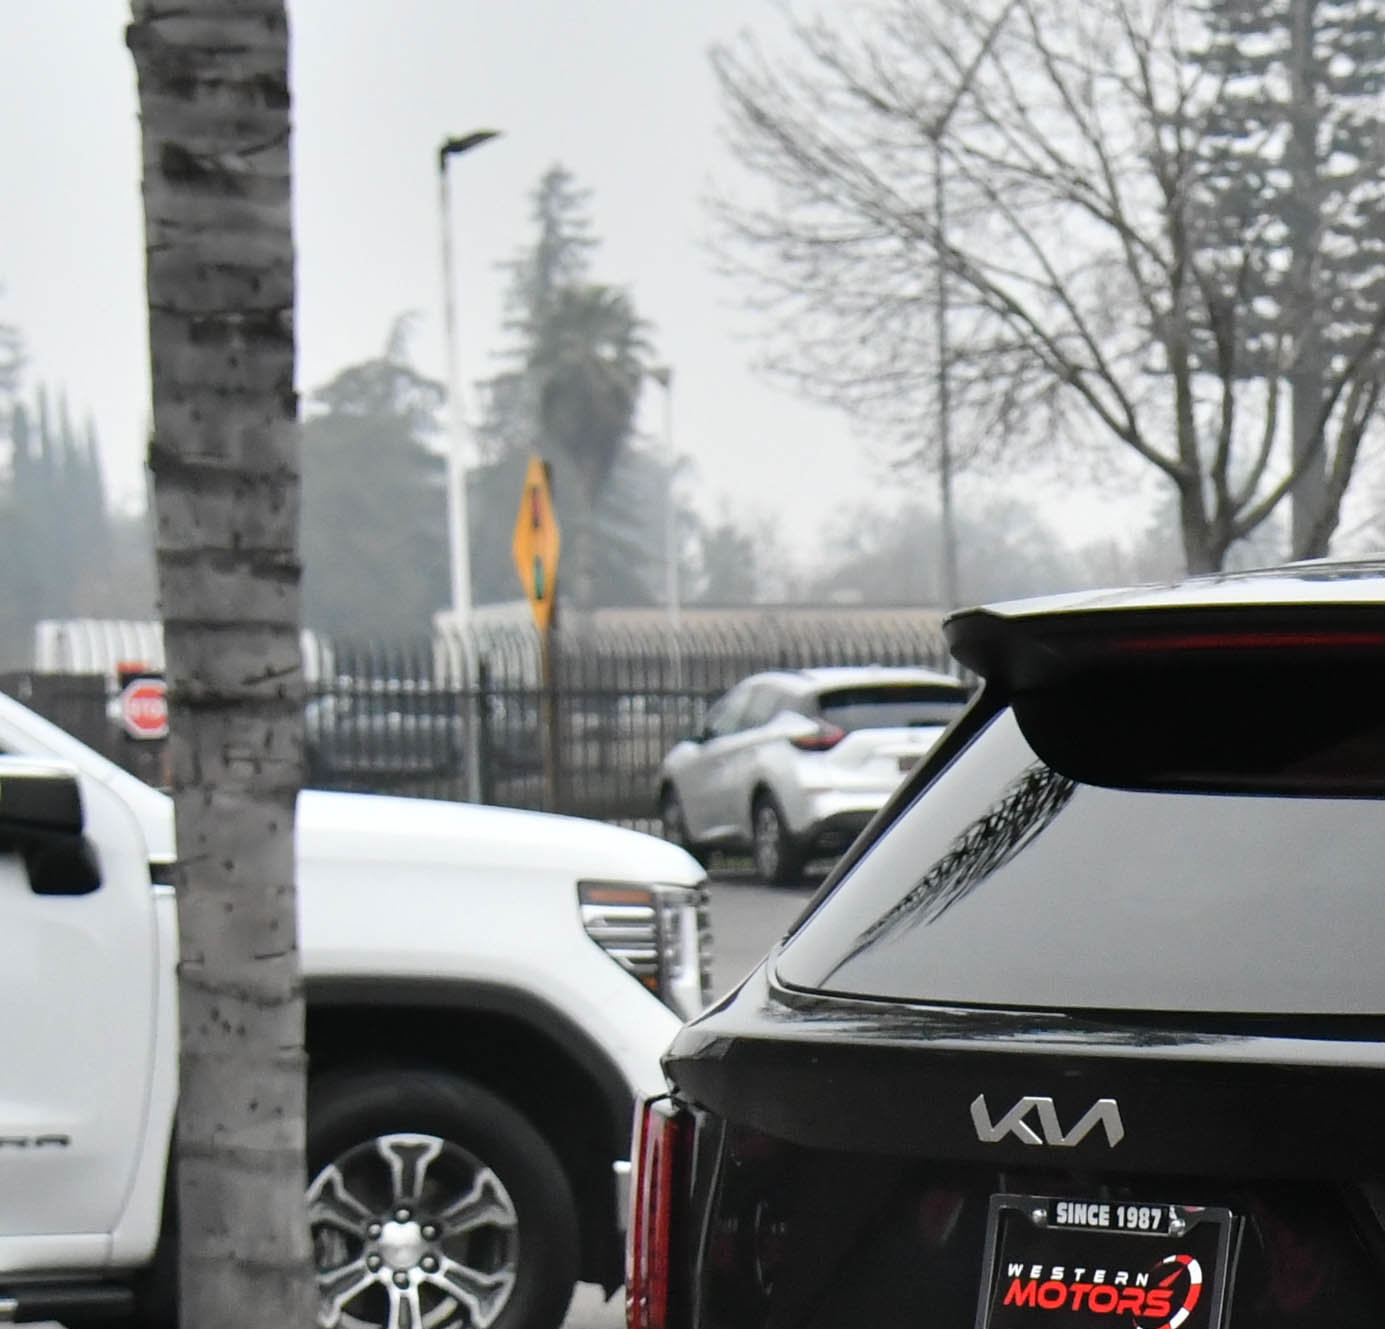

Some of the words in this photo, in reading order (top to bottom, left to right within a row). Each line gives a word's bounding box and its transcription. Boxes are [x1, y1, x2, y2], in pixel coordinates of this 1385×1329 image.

[970, 1094, 1125, 1148] KIA
[1056, 1203, 1110, 1226] SINCE
[1116, 1206, 1162, 1229] 1987
[1007, 1263, 1149, 1286] WESTERN
[1003, 1279, 1173, 1317] MOTORS
